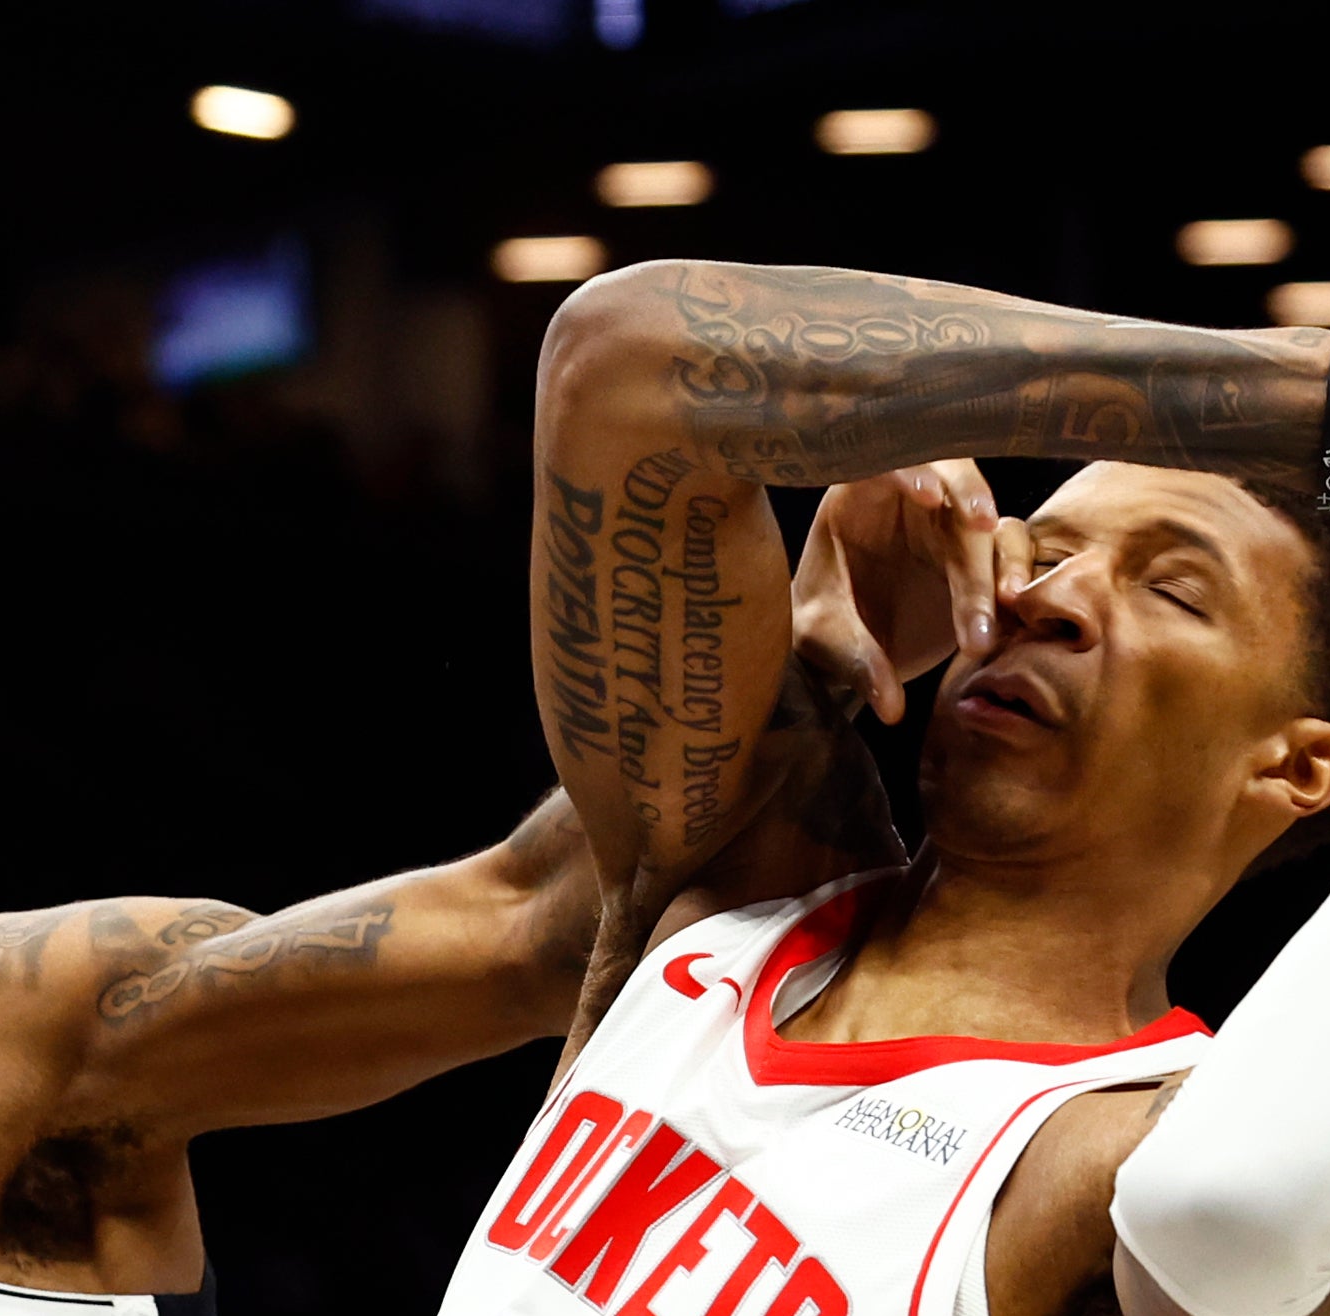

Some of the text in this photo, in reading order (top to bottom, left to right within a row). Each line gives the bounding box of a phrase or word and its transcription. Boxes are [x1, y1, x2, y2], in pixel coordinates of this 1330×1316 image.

[663, 494, 743, 735] Complacency
[834, 1108, 961, 1166] HERMANN
[848, 1096, 968, 1150] MEMORIAL
